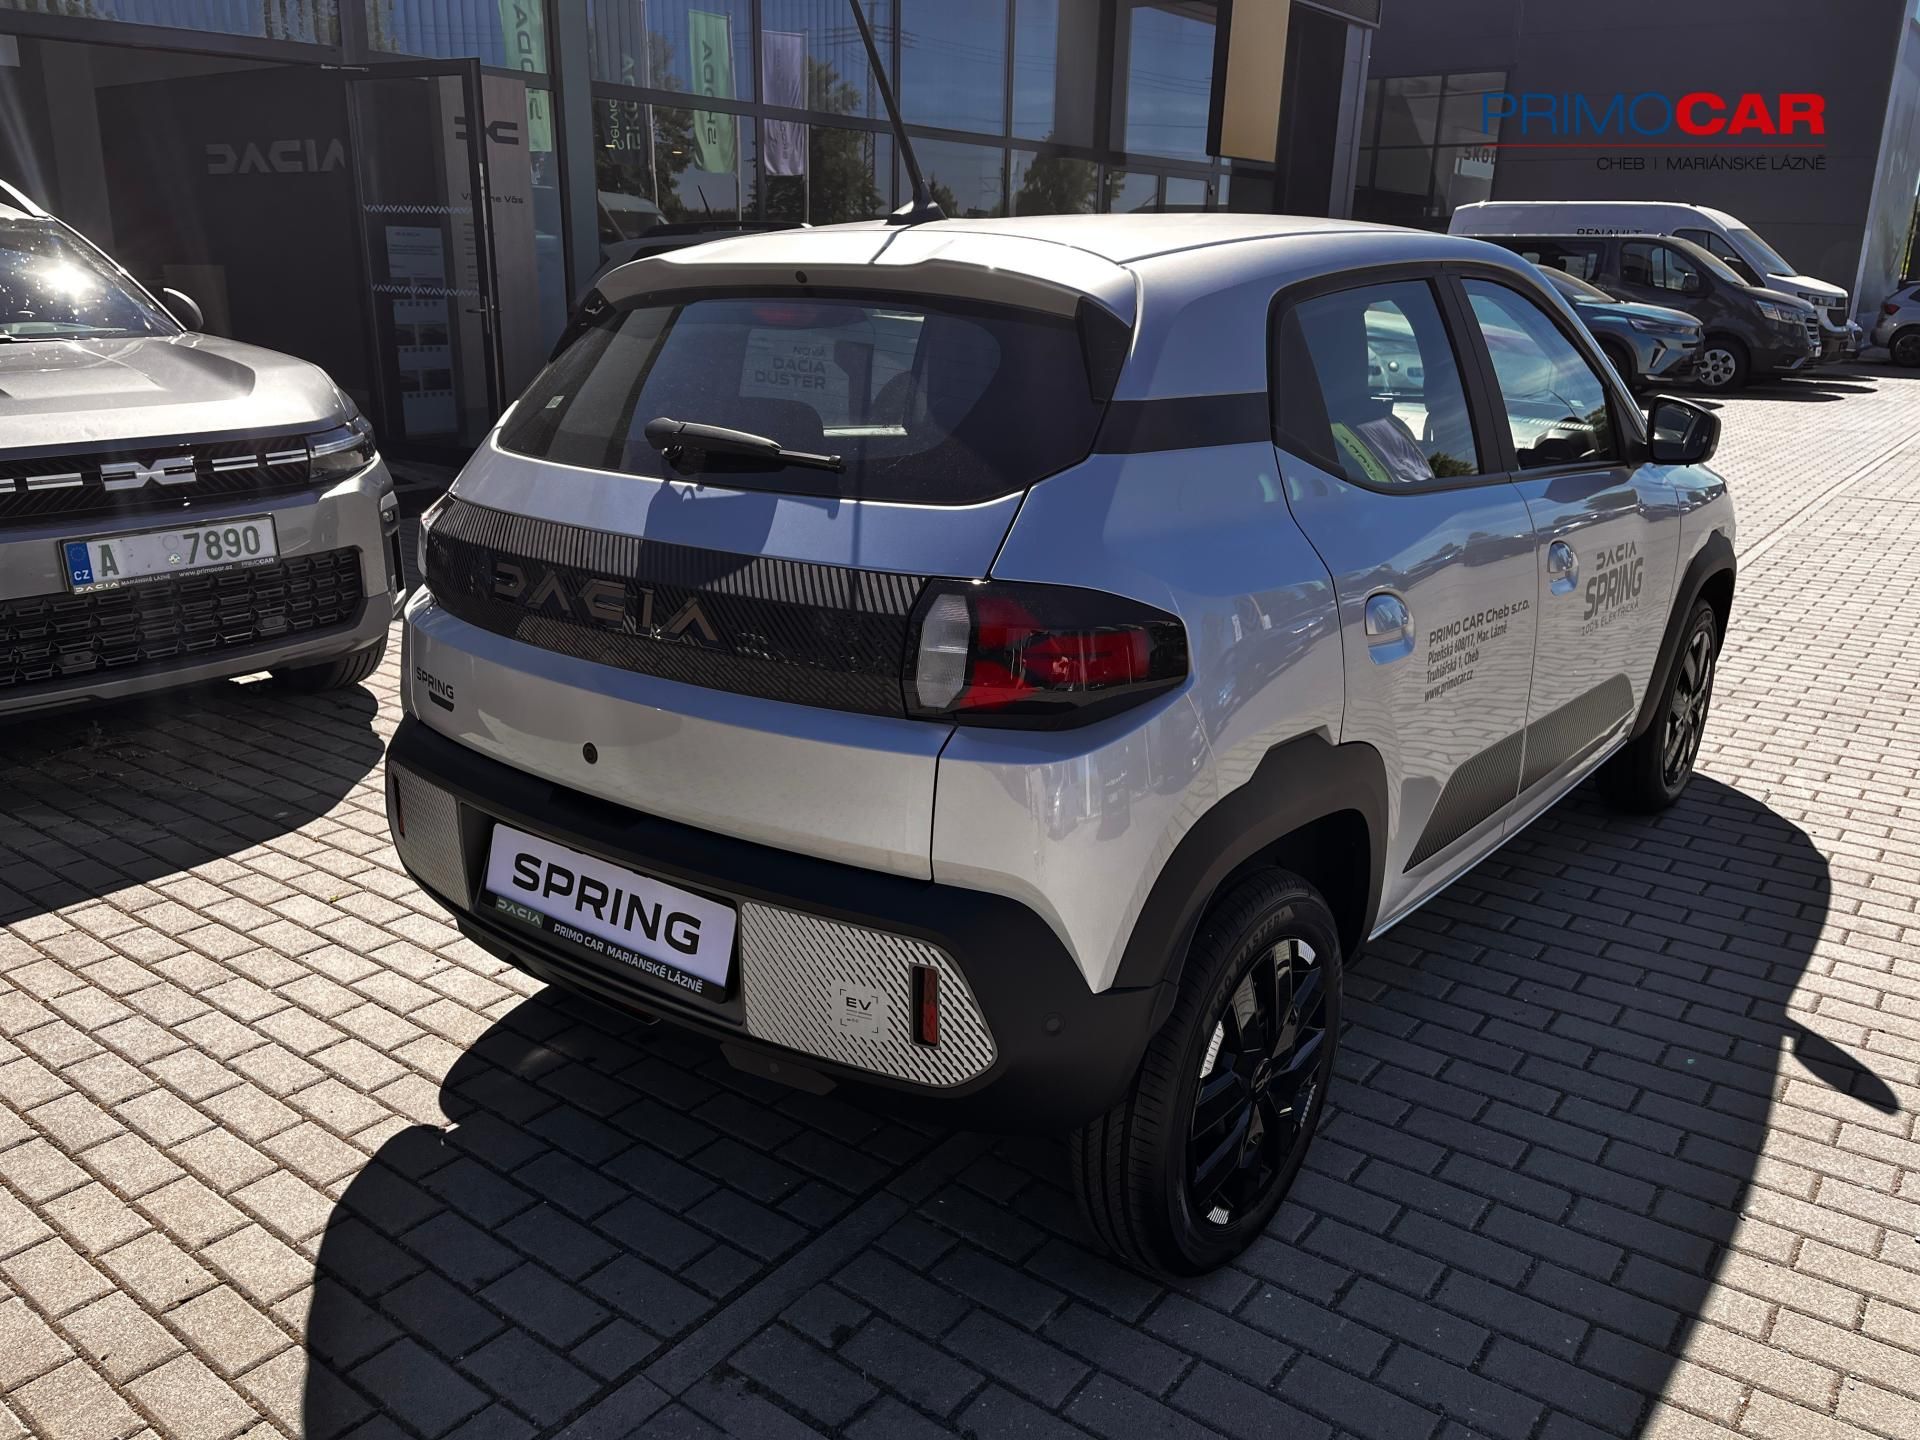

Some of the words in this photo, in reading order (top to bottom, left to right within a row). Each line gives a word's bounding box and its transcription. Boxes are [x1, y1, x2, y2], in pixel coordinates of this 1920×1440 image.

[754, 370, 827, 390] DUSTER
[773, 357, 826, 375] DACIA
[183, 525, 262, 565] 7890
[1596, 540, 1637, 571] DACIA
[73, 569, 91, 581] CZ
[74, 581, 120, 594] DACIA
[1583, 557, 1644, 621] SPRING
[494, 561, 718, 643] DACIA
[1429, 620, 1461, 648] PRIMO
[1462, 612, 1485, 633] CAR
[1485, 604, 1510, 624] Cheb
[1511, 599, 1530, 615] s.r.o.
[1464, 647, 1480, 666] Cheb
[416, 666, 455, 700] SPRING
[512, 852, 702, 955] SPRING
[497, 899, 542, 925] DACIA
[554, 923, 583, 945] PRIMO
[584, 933, 604, 953] CAR
[606, 944, 667, 978] MARIÁNSKÉ
[667, 968, 703, 994] LÁZNĚ
[846, 996, 872, 1011] EV
